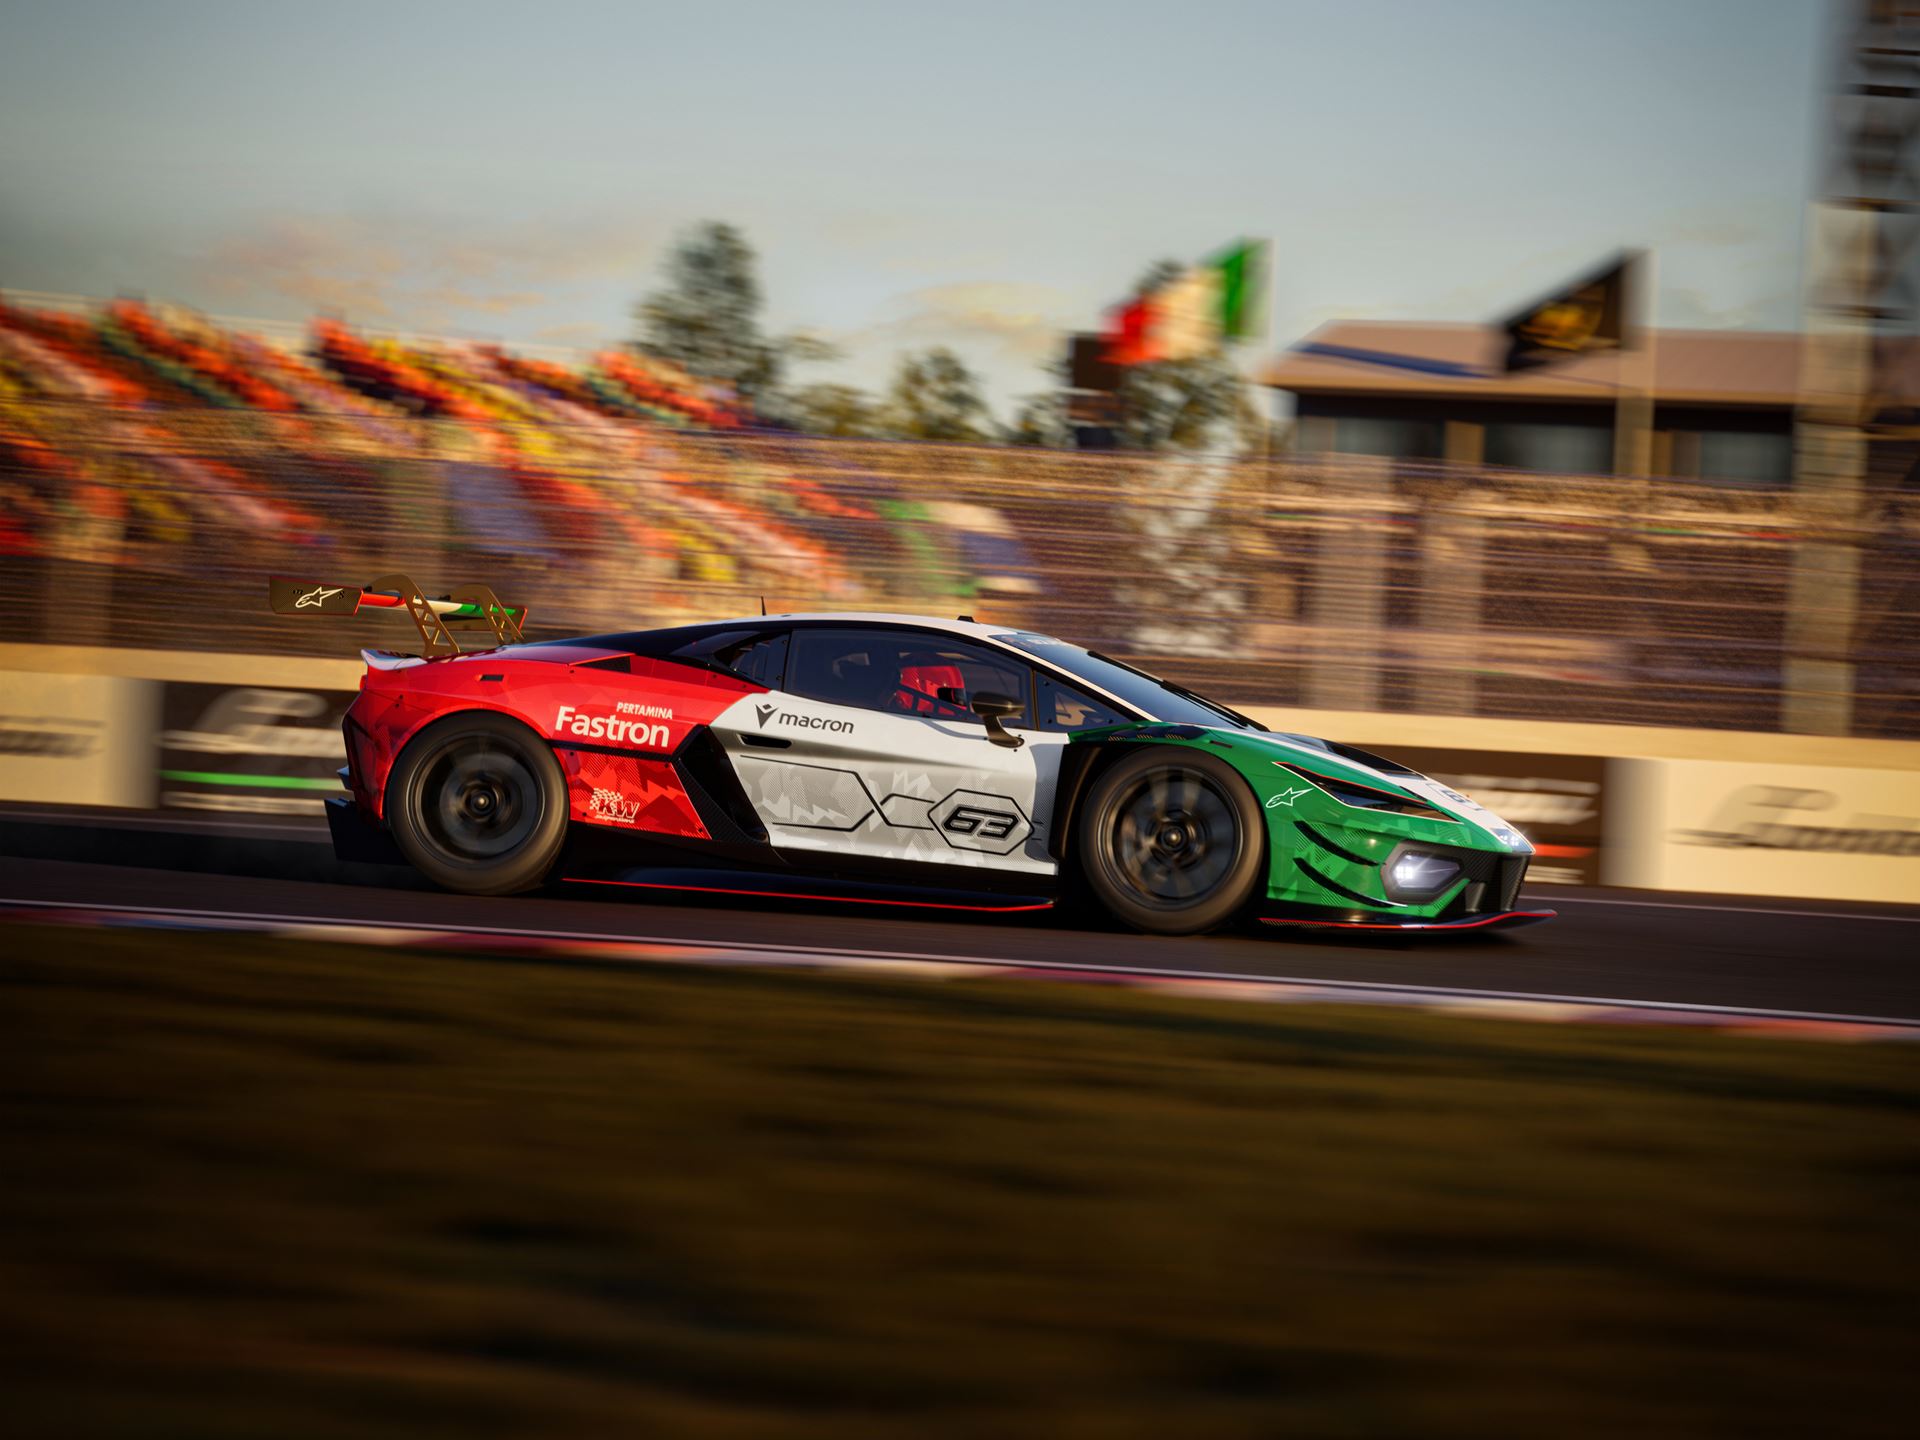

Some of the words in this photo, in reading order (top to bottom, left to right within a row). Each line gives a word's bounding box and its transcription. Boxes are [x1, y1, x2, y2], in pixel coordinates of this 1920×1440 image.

[616, 701, 673, 720] PERTAMINA
[556, 706, 670, 747] Fastron
[778, 712, 854, 734] macron
[597, 798, 640, 819] KW
[942, 804, 1020, 841] 63
